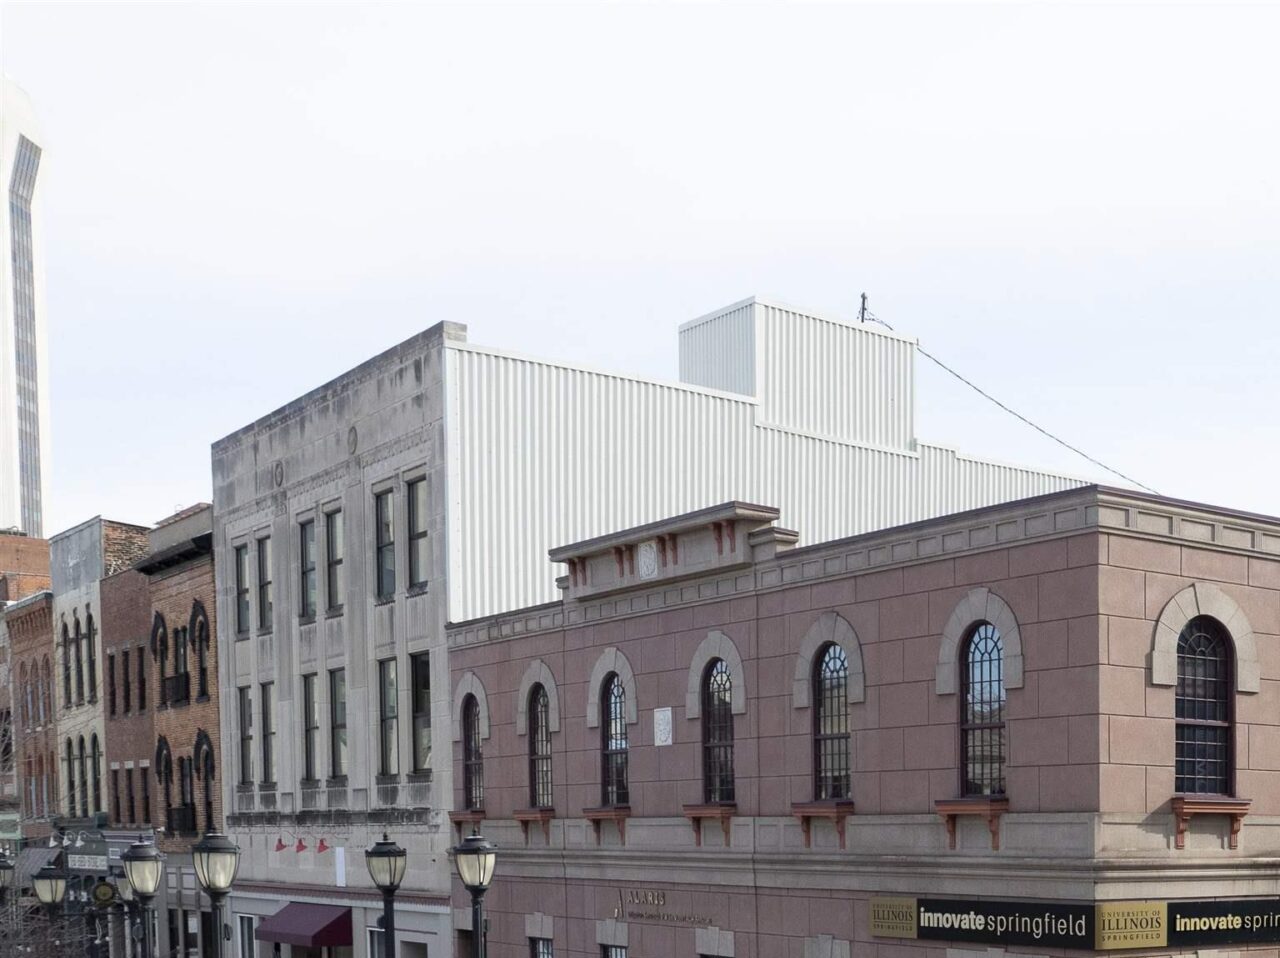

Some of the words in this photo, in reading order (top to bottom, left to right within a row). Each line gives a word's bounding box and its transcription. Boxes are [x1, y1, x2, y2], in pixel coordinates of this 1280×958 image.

[873, 909, 913, 921] ILLINOIS
[1176, 914, 1242, 931] innovate
[920, 907, 985, 930] innovate
[987, 913, 1086, 939] springfield
[1101, 916, 1161, 931] ILLINOIS
[1101, 933, 1161, 942] SPRINGFIELD
